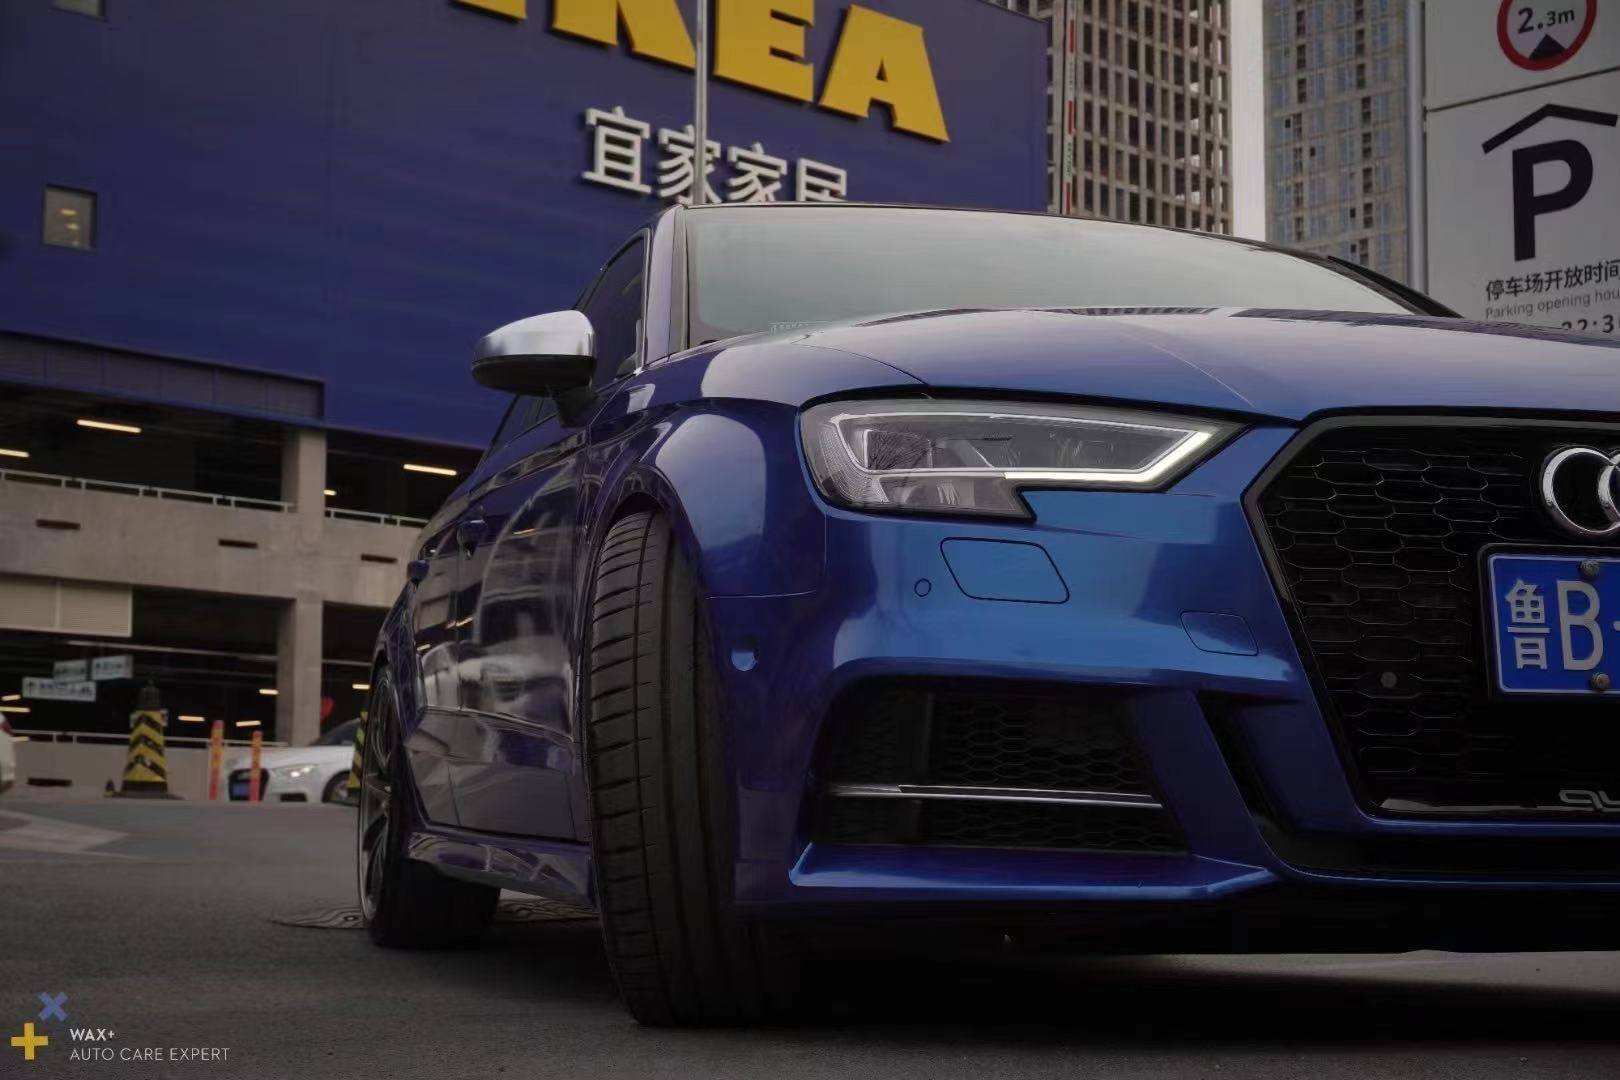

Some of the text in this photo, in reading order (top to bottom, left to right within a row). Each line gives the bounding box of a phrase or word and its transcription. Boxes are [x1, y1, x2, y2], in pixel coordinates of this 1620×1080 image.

[1517, 7, 1575, 34] 2.3m
[450, 0, 950, 143] EA
[1512, 139, 1593, 262] P
[1486, 259, 1620, 301] 停车场开放时间
[1485, 303, 1534, 319] Parking
[1537, 293, 1591, 311] opening
